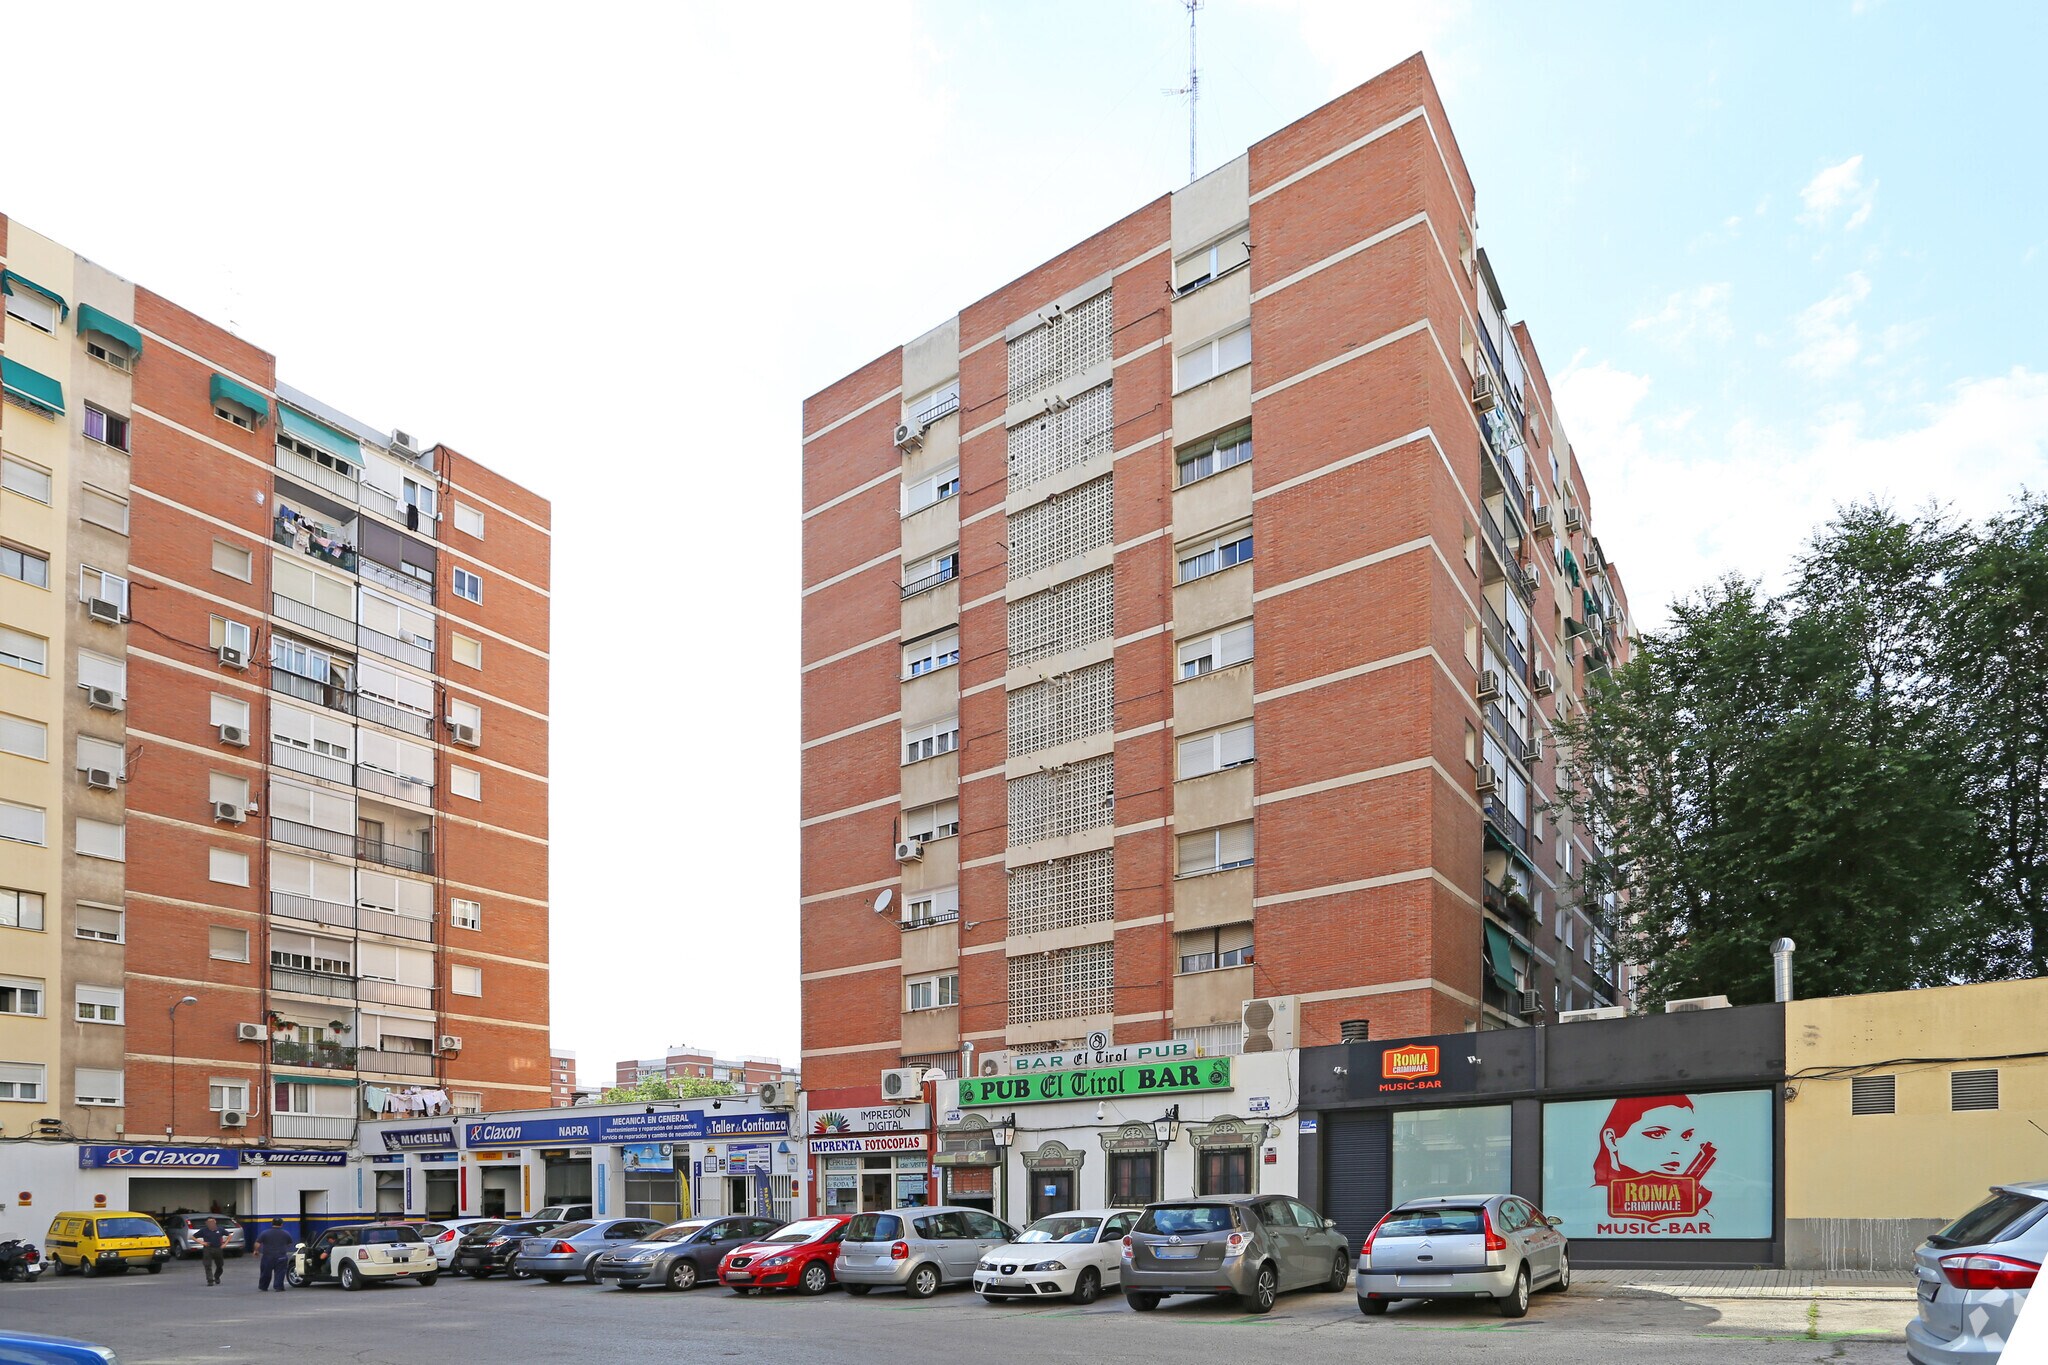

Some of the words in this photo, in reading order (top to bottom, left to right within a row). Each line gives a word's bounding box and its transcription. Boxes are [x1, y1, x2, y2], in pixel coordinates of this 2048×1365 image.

[1016, 1056, 1063, 1070] BAR
[1073, 1052, 1088, 1066] El
[1095, 1048, 1128, 1063] Tirol
[1138, 1044, 1188, 1059] PUB
[1393, 1052, 1428, 1066] ROMA
[1392, 1064, 1428, 1073] CRIMINALE
[981, 1079, 1030, 1100] PUB
[1040, 1074, 1064, 1098] El
[1070, 1069, 1126, 1096] Tirol
[1138, 1065, 1200, 1089] BAR
[1379, 1080, 1442, 1091] MUSIC-BAR
[612, 1116, 646, 1126] MECANICA
[647, 1115, 657, 1124] EN
[657, 1114, 689, 1123] GENERAL
[860, 1107, 911, 1120] IMPRESIÓN
[711, 1120, 735, 1133] Taller
[741, 1117, 787, 1132] Confianza
[868, 1121, 903, 1131] DIGITAL
[401, 1133, 451, 1144] MICHELIN
[484, 1126, 521, 1140] Claxon
[558, 1126, 590, 1137] NAPRA
[811, 1140, 862, 1152] IMPRENTA
[865, 1137, 920, 1151] FOTOCOPIAS
[138, 1150, 220, 1165] Claxon
[268, 1154, 342, 1162] MICHELIN
[1625, 1182, 1681, 1201] ROMA
[1624, 1201, 1681, 1211] CRIMINALE
[1597, 1222, 1711, 1234] MUSIC-BAR
